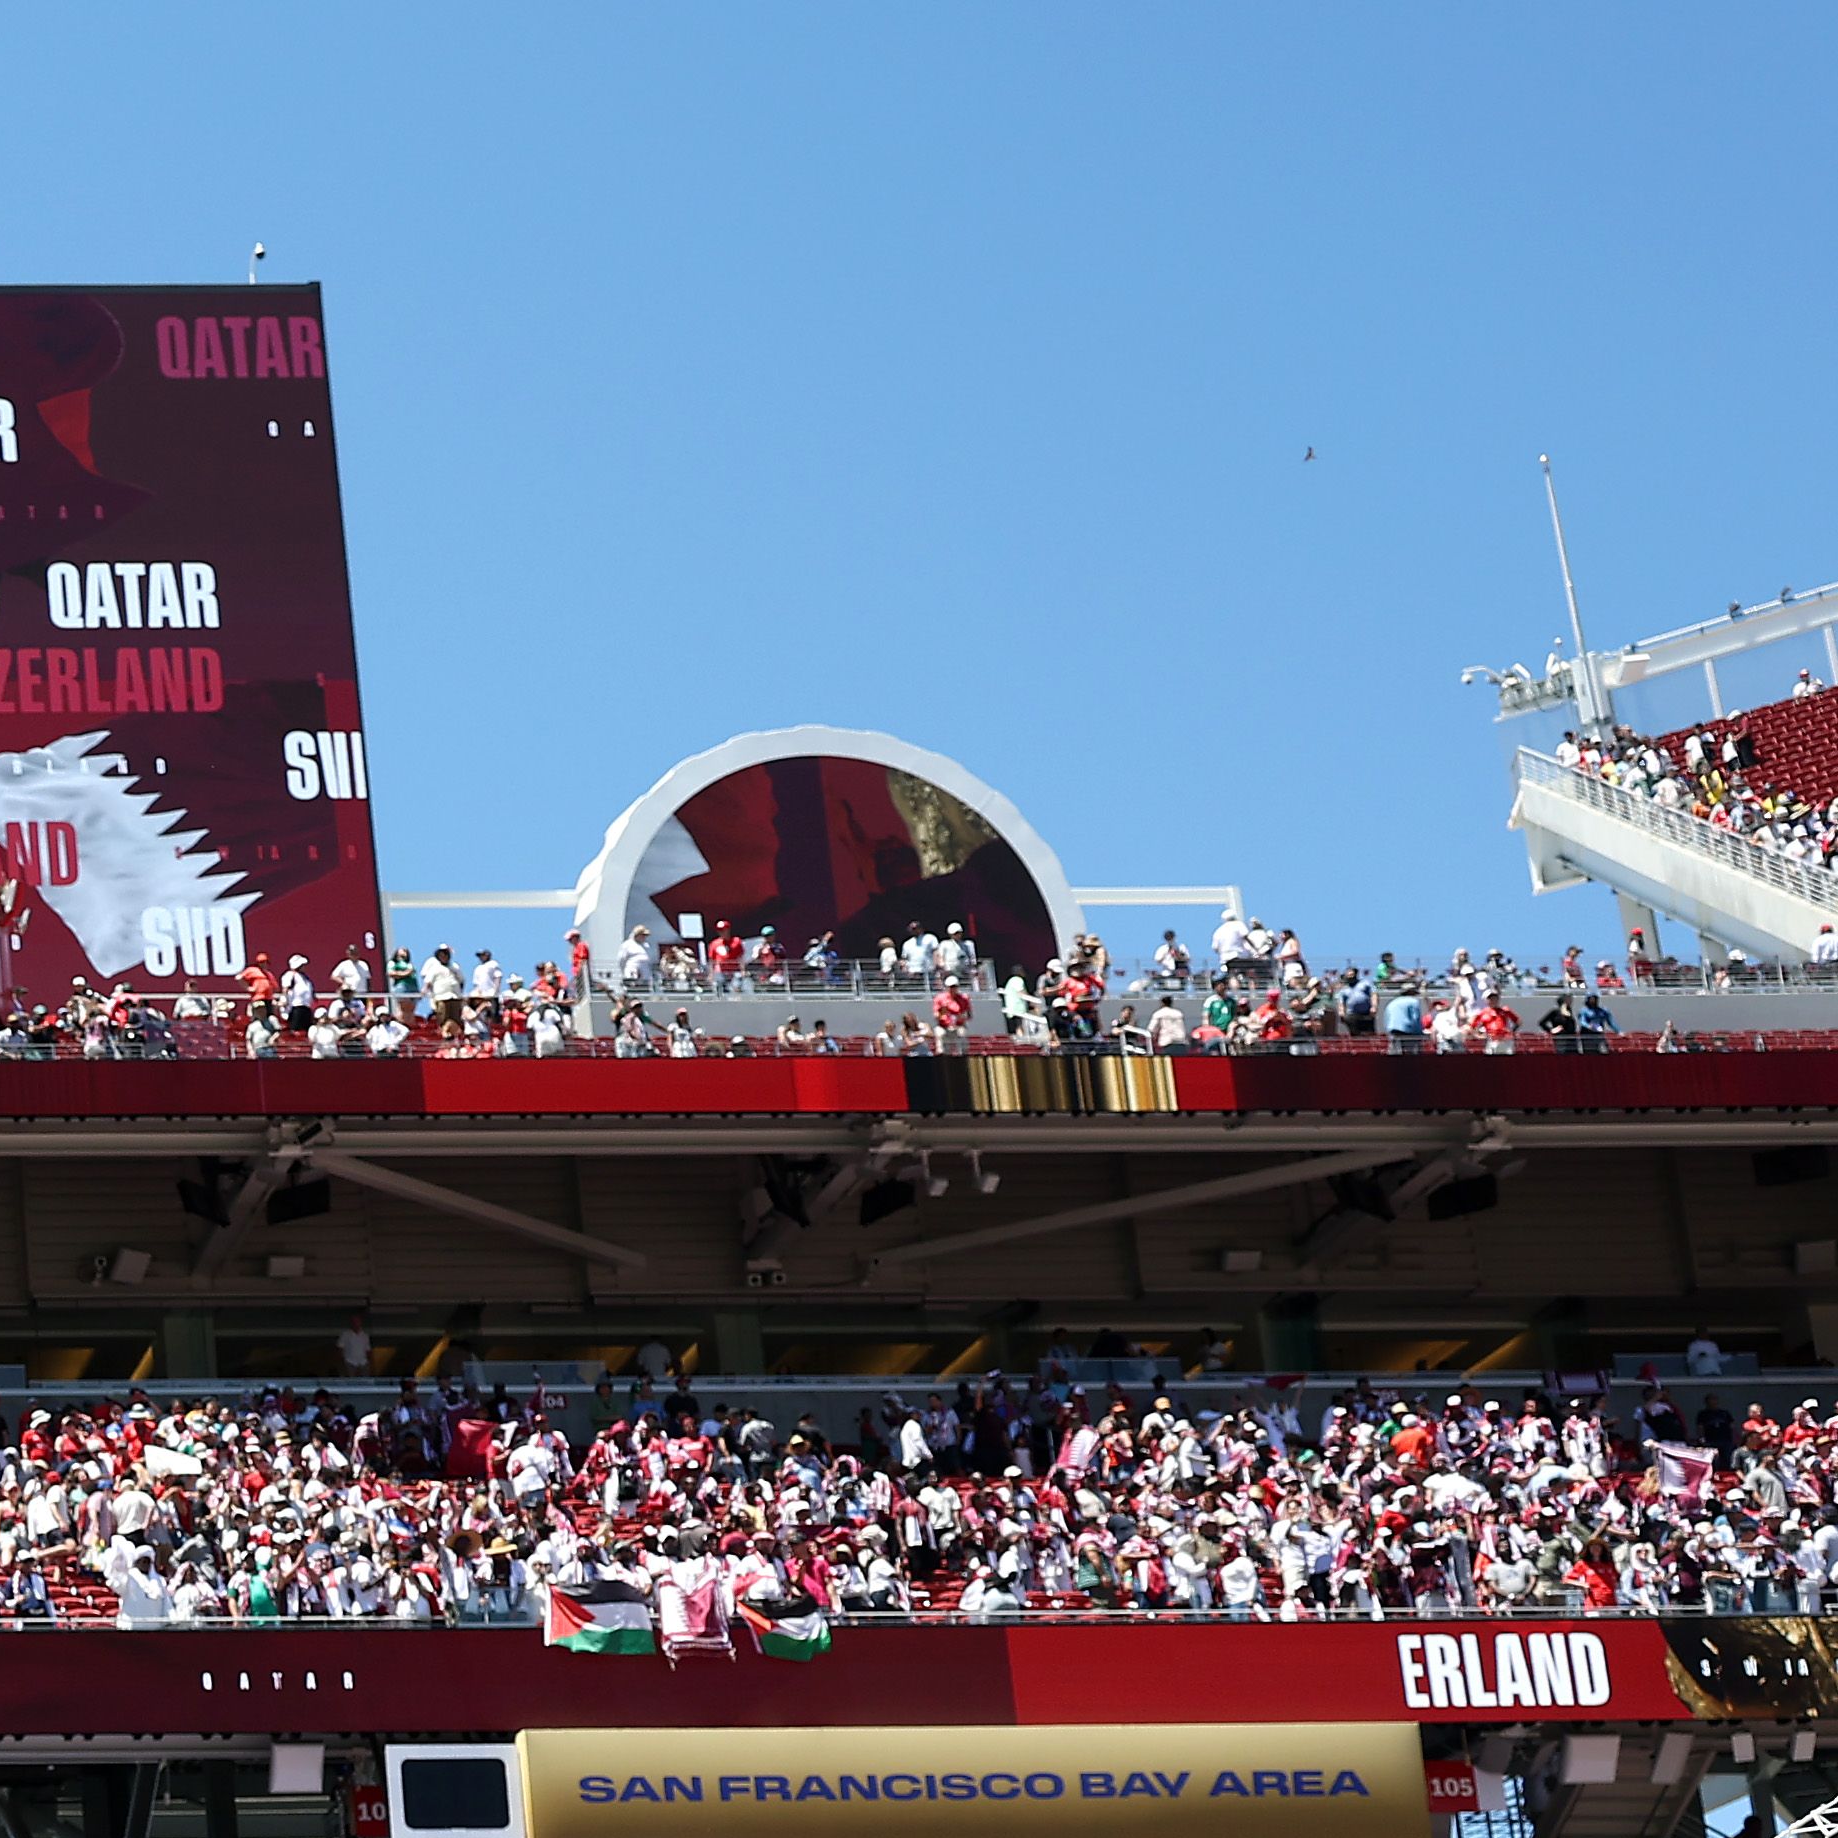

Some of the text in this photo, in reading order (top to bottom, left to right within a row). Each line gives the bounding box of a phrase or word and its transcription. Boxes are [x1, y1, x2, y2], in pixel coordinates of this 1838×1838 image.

[156, 316, 324, 378] QATAR
[46, 562, 221, 630] QATAR
[1398, 1632, 1610, 1707] ERLAND
[578, 1769, 1370, 1803] SAN FRANCISCO BAY AREA
[1430, 1777, 1474, 1798] 105
